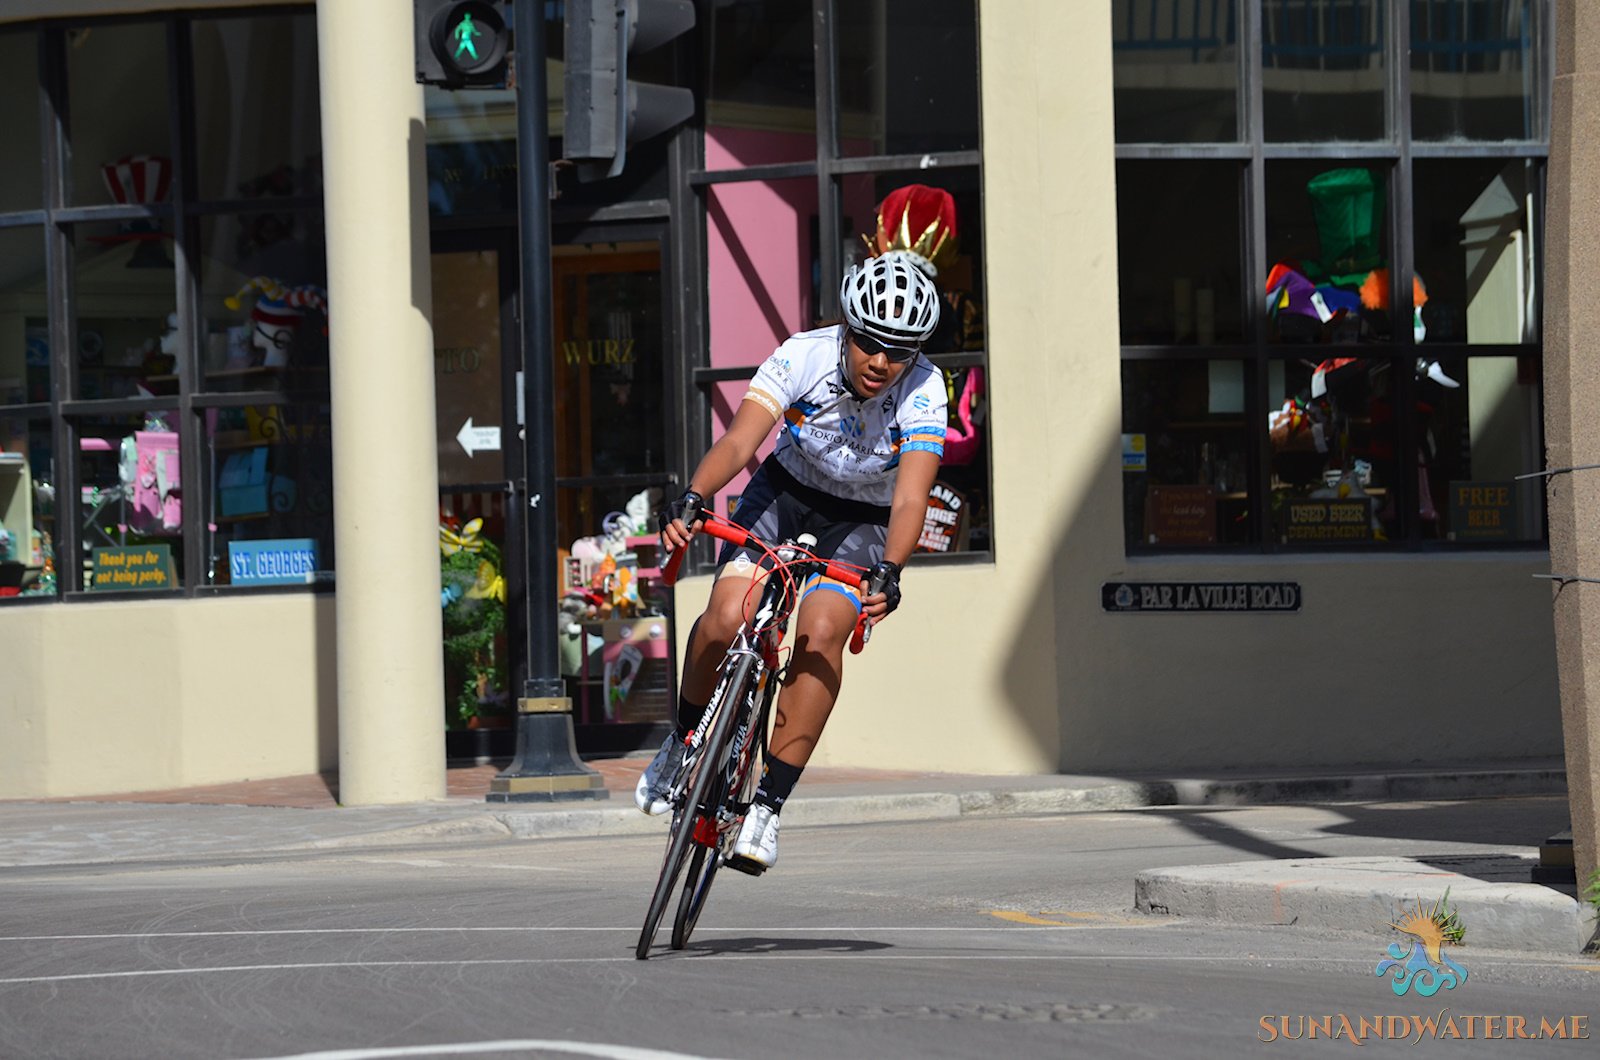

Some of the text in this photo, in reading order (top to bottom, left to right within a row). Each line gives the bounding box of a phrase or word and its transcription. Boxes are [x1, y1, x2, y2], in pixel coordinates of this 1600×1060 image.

[561, 337, 637, 367] WURZ
[809, 427, 885, 456] TOKIO MARINE
[1457, 487, 1509, 507] FREE
[1290, 503, 1364, 523] USED BEER
[1468, 509, 1500, 528] BEER
[1288, 525, 1368, 539] DEPARTMENT
[99, 550, 159, 568] Thank you for
[232, 549, 319, 579] ST. GEORGES
[96, 570, 112, 583] not
[113, 568, 137, 586] being
[1140, 585, 1173, 608] PAR
[1251, 584, 1296, 608] ROAD
